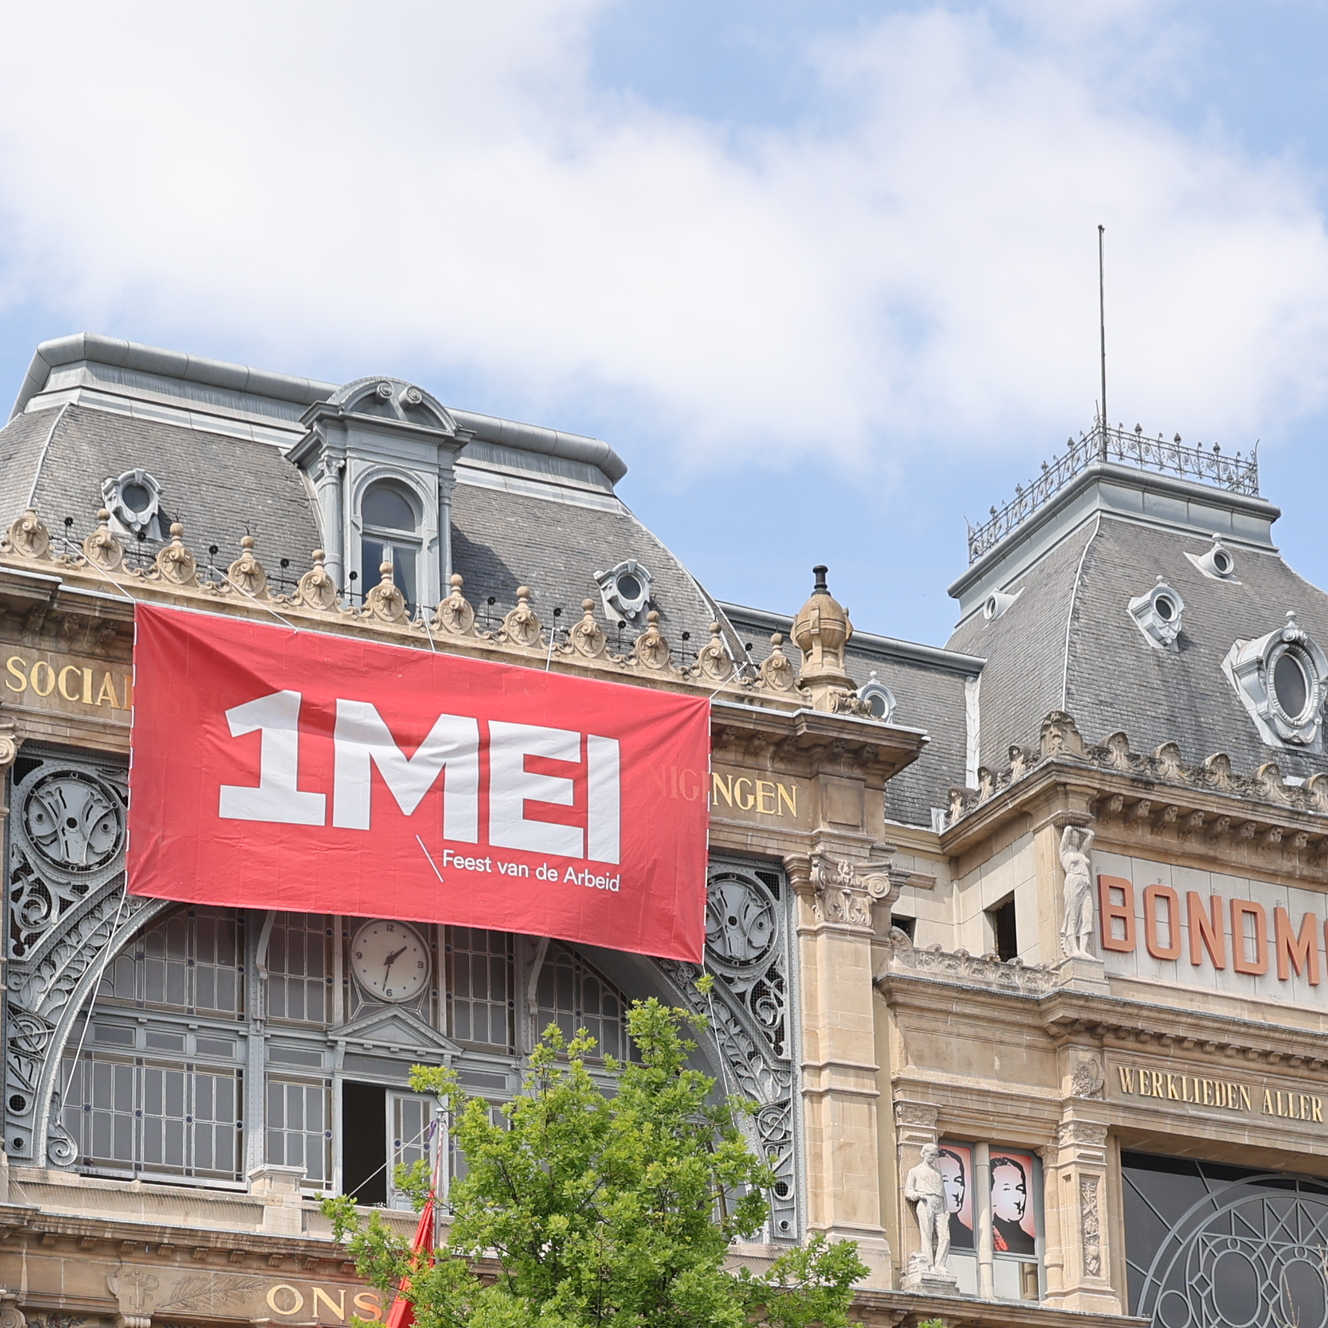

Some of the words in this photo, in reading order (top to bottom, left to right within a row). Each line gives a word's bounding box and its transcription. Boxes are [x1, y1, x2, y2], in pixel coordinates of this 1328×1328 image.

[442, 850, 491, 874] Feest
[496, 860, 528, 879] van
[536, 863, 558, 883] de
[563, 867, 620, 892] Arbeid
[386, 989, 392, 997] 6
[1119, 1066, 1252, 1112] WERKLIEDEN
[1263, 1088, 1323, 1122] ALLER
[266, 1284, 383, 1322] ONS
